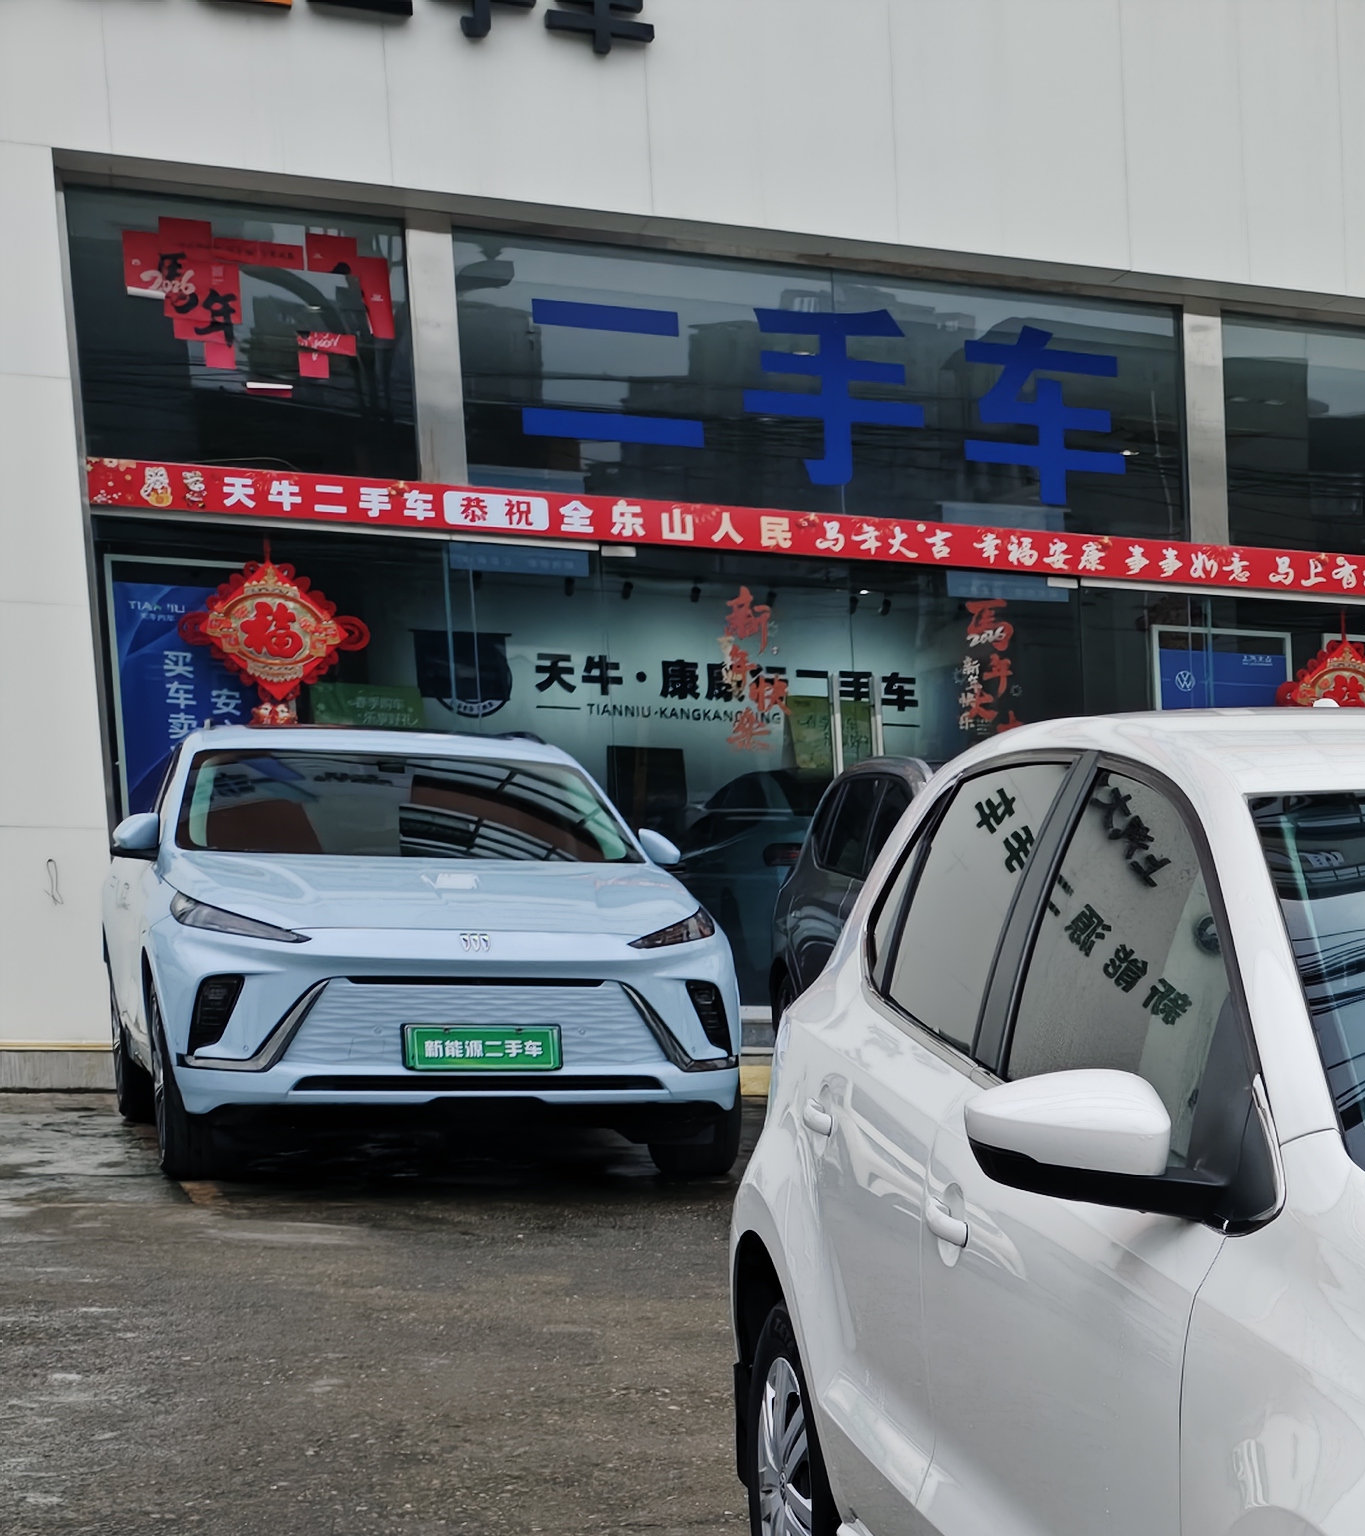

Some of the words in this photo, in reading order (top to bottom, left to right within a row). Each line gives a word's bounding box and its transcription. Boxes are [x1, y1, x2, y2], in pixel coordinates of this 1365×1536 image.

[522, 298, 1126, 506] 二手车
[973, 532, 1106, 572] 幸福安康
[240, 601, 303, 658] 福
[424, 1040, 543, 1058] 新能源二手车
